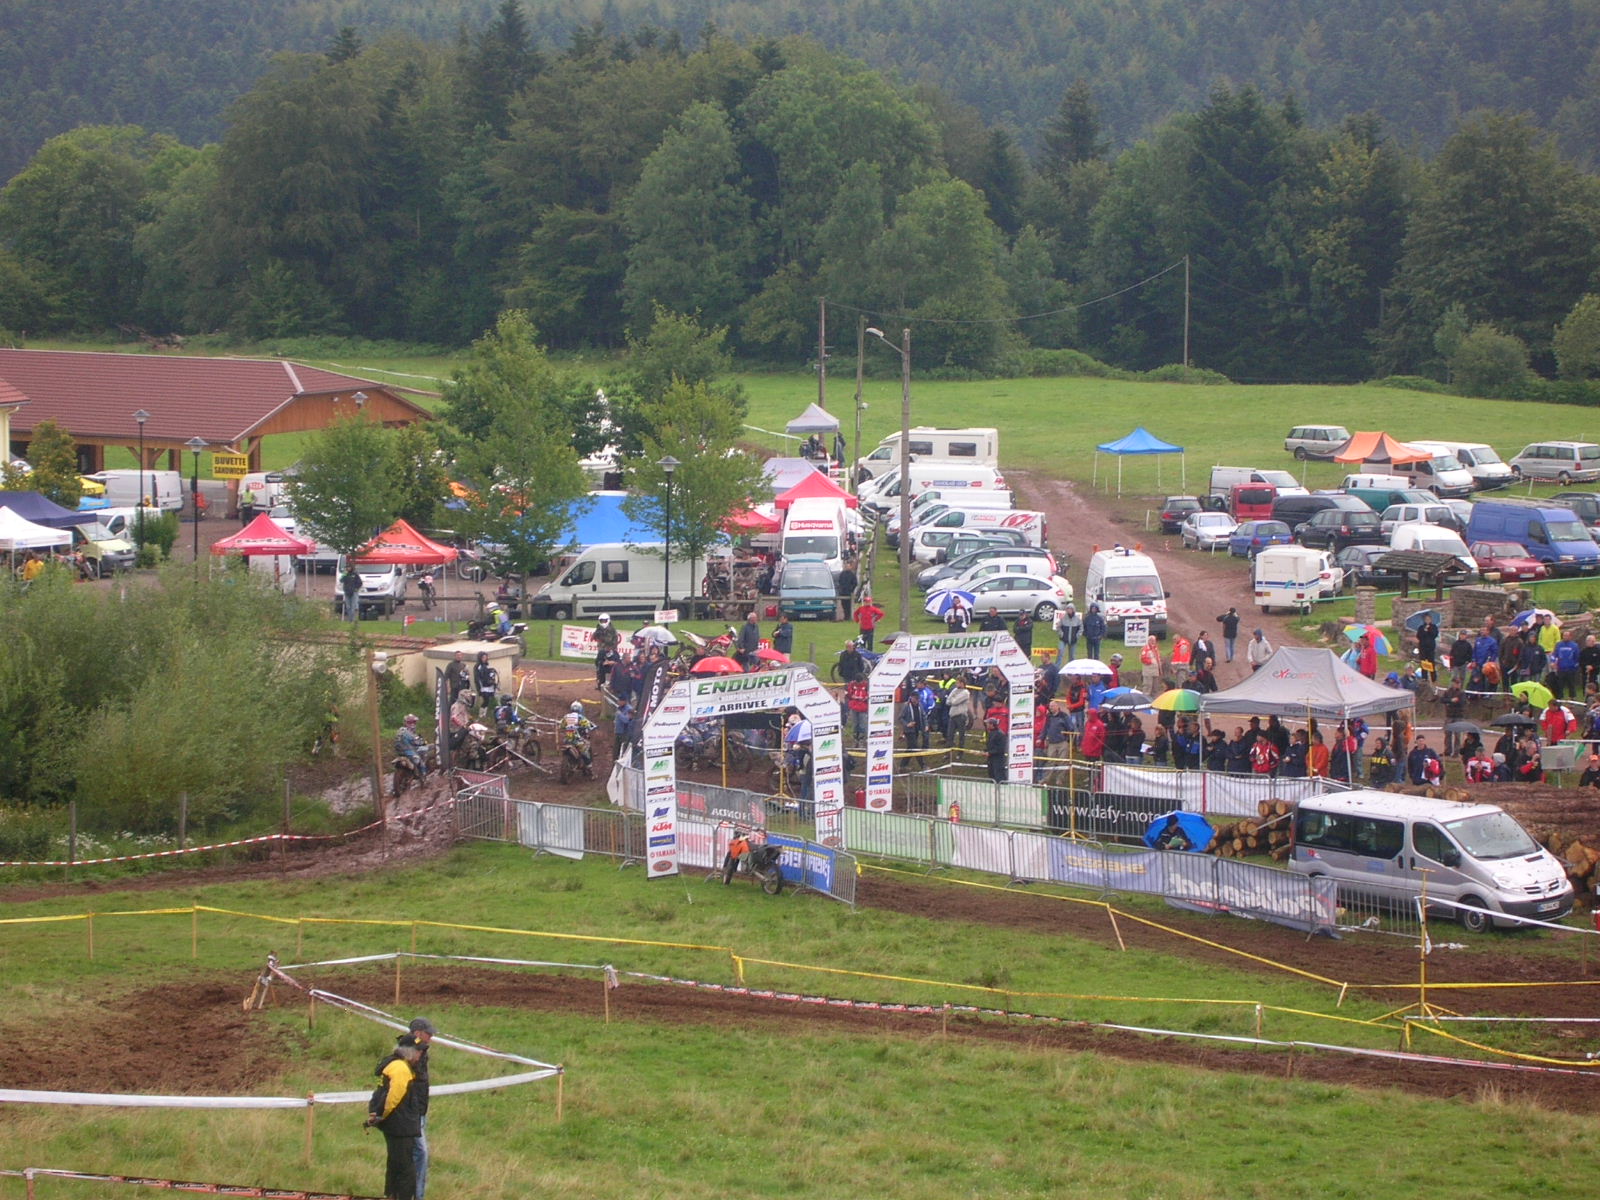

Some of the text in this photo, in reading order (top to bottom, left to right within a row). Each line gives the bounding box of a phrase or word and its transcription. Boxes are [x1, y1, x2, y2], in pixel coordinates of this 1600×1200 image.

[214, 456, 246, 466] BUVETTE
[915, 635, 992, 651] ENDURO
[934, 658, 974, 668] DEPART
[696, 673, 788, 696] ENDURO
[872, 764, 889, 772] KTM
[652, 822, 673, 832] KTM
